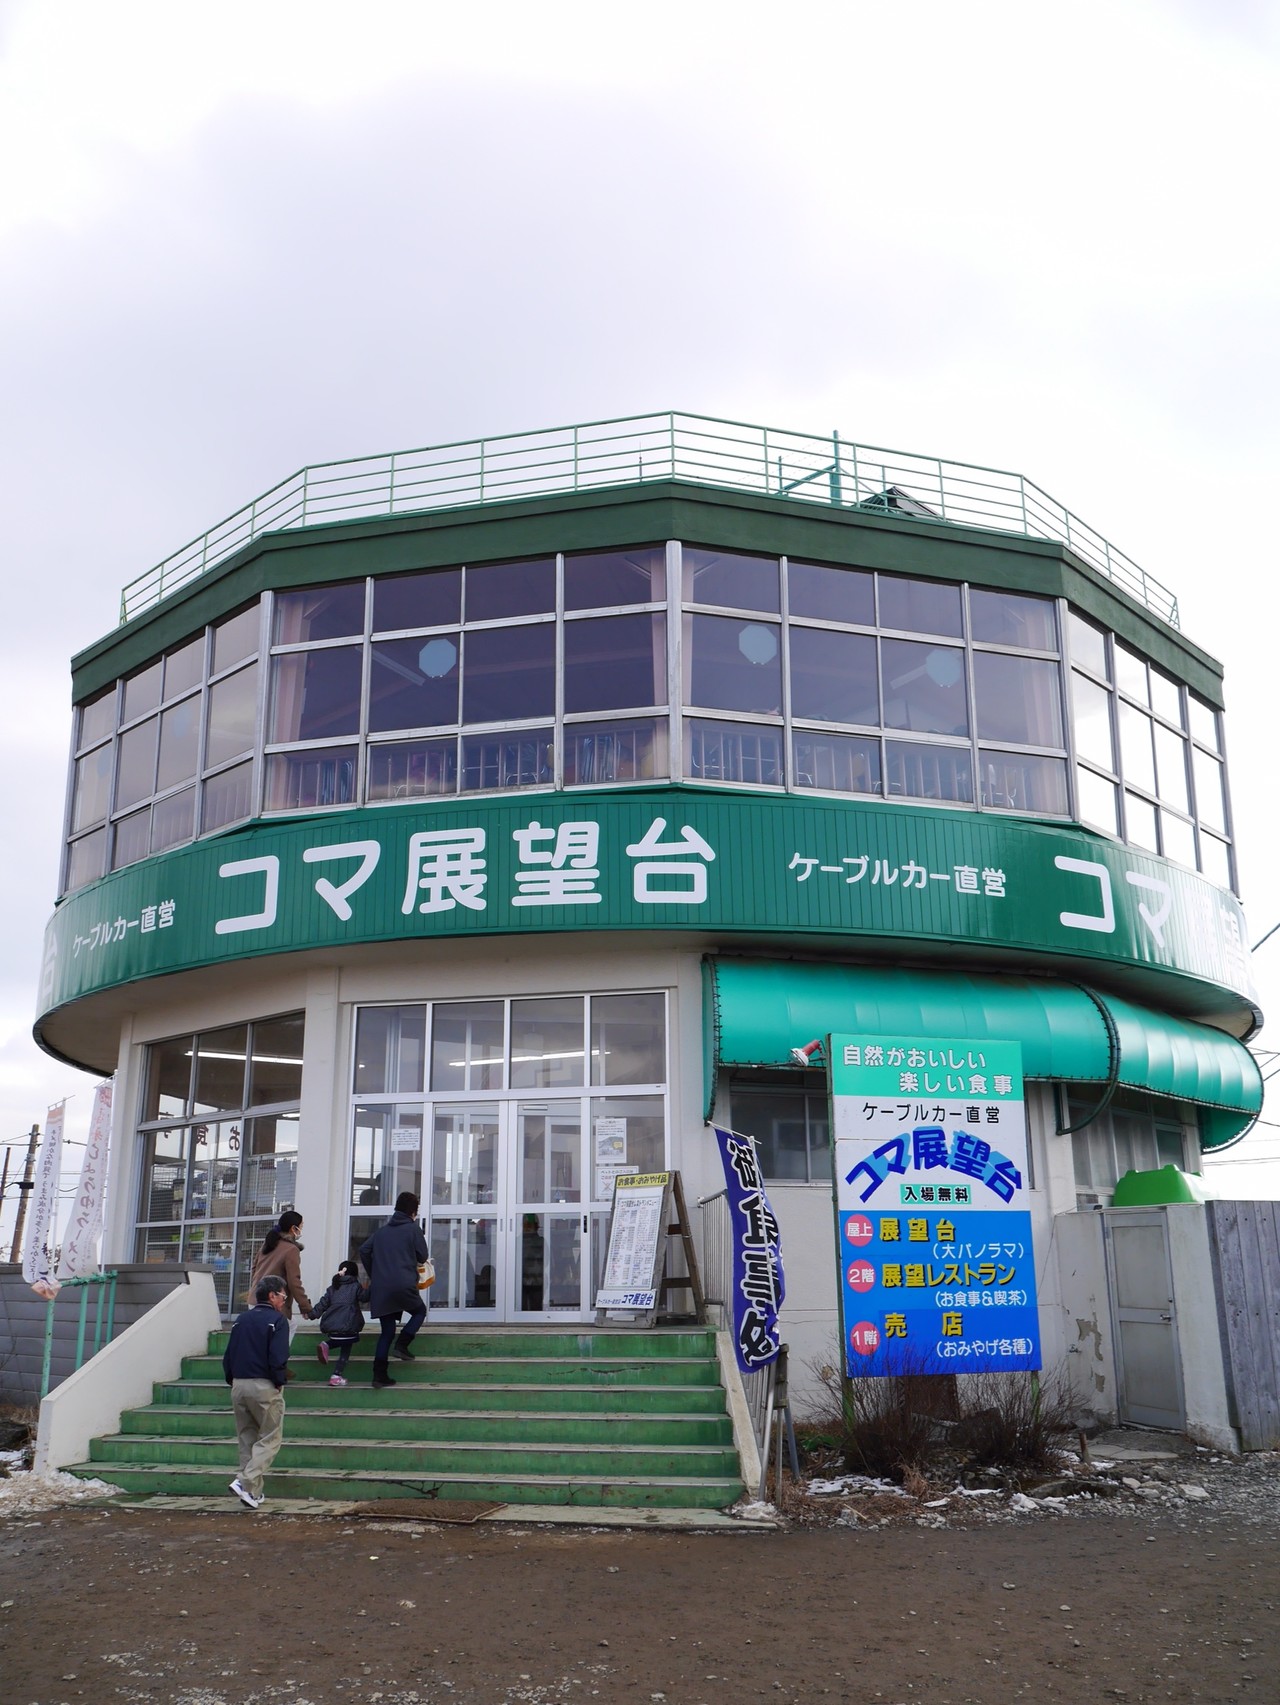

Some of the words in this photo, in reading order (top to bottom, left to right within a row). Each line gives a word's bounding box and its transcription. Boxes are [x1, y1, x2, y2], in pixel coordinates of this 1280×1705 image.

[215, 817, 715, 935] コマ展望台
[789, 852, 1006, 898] ケーブルカー直営
[73, 898, 176, 958] ケーブルカー直営
[842, 1044, 986, 1069] 自然がおいしい
[899, 1071, 1014, 1095] 楽しい食事
[862, 1102, 1000, 1124] ケーブルカー直営
[844, 1125, 1023, 1204] コマ展望台
[903, 1185, 969, 1202] 入場無料
[846, 1222, 873, 1238] 屋上
[879, 1217, 956, 1243] 展望台
[849, 1268, 875, 1284] 2階
[881, 1262, 1016, 1288] 展望レストラン
[852, 1330, 878, 1347] 1階
